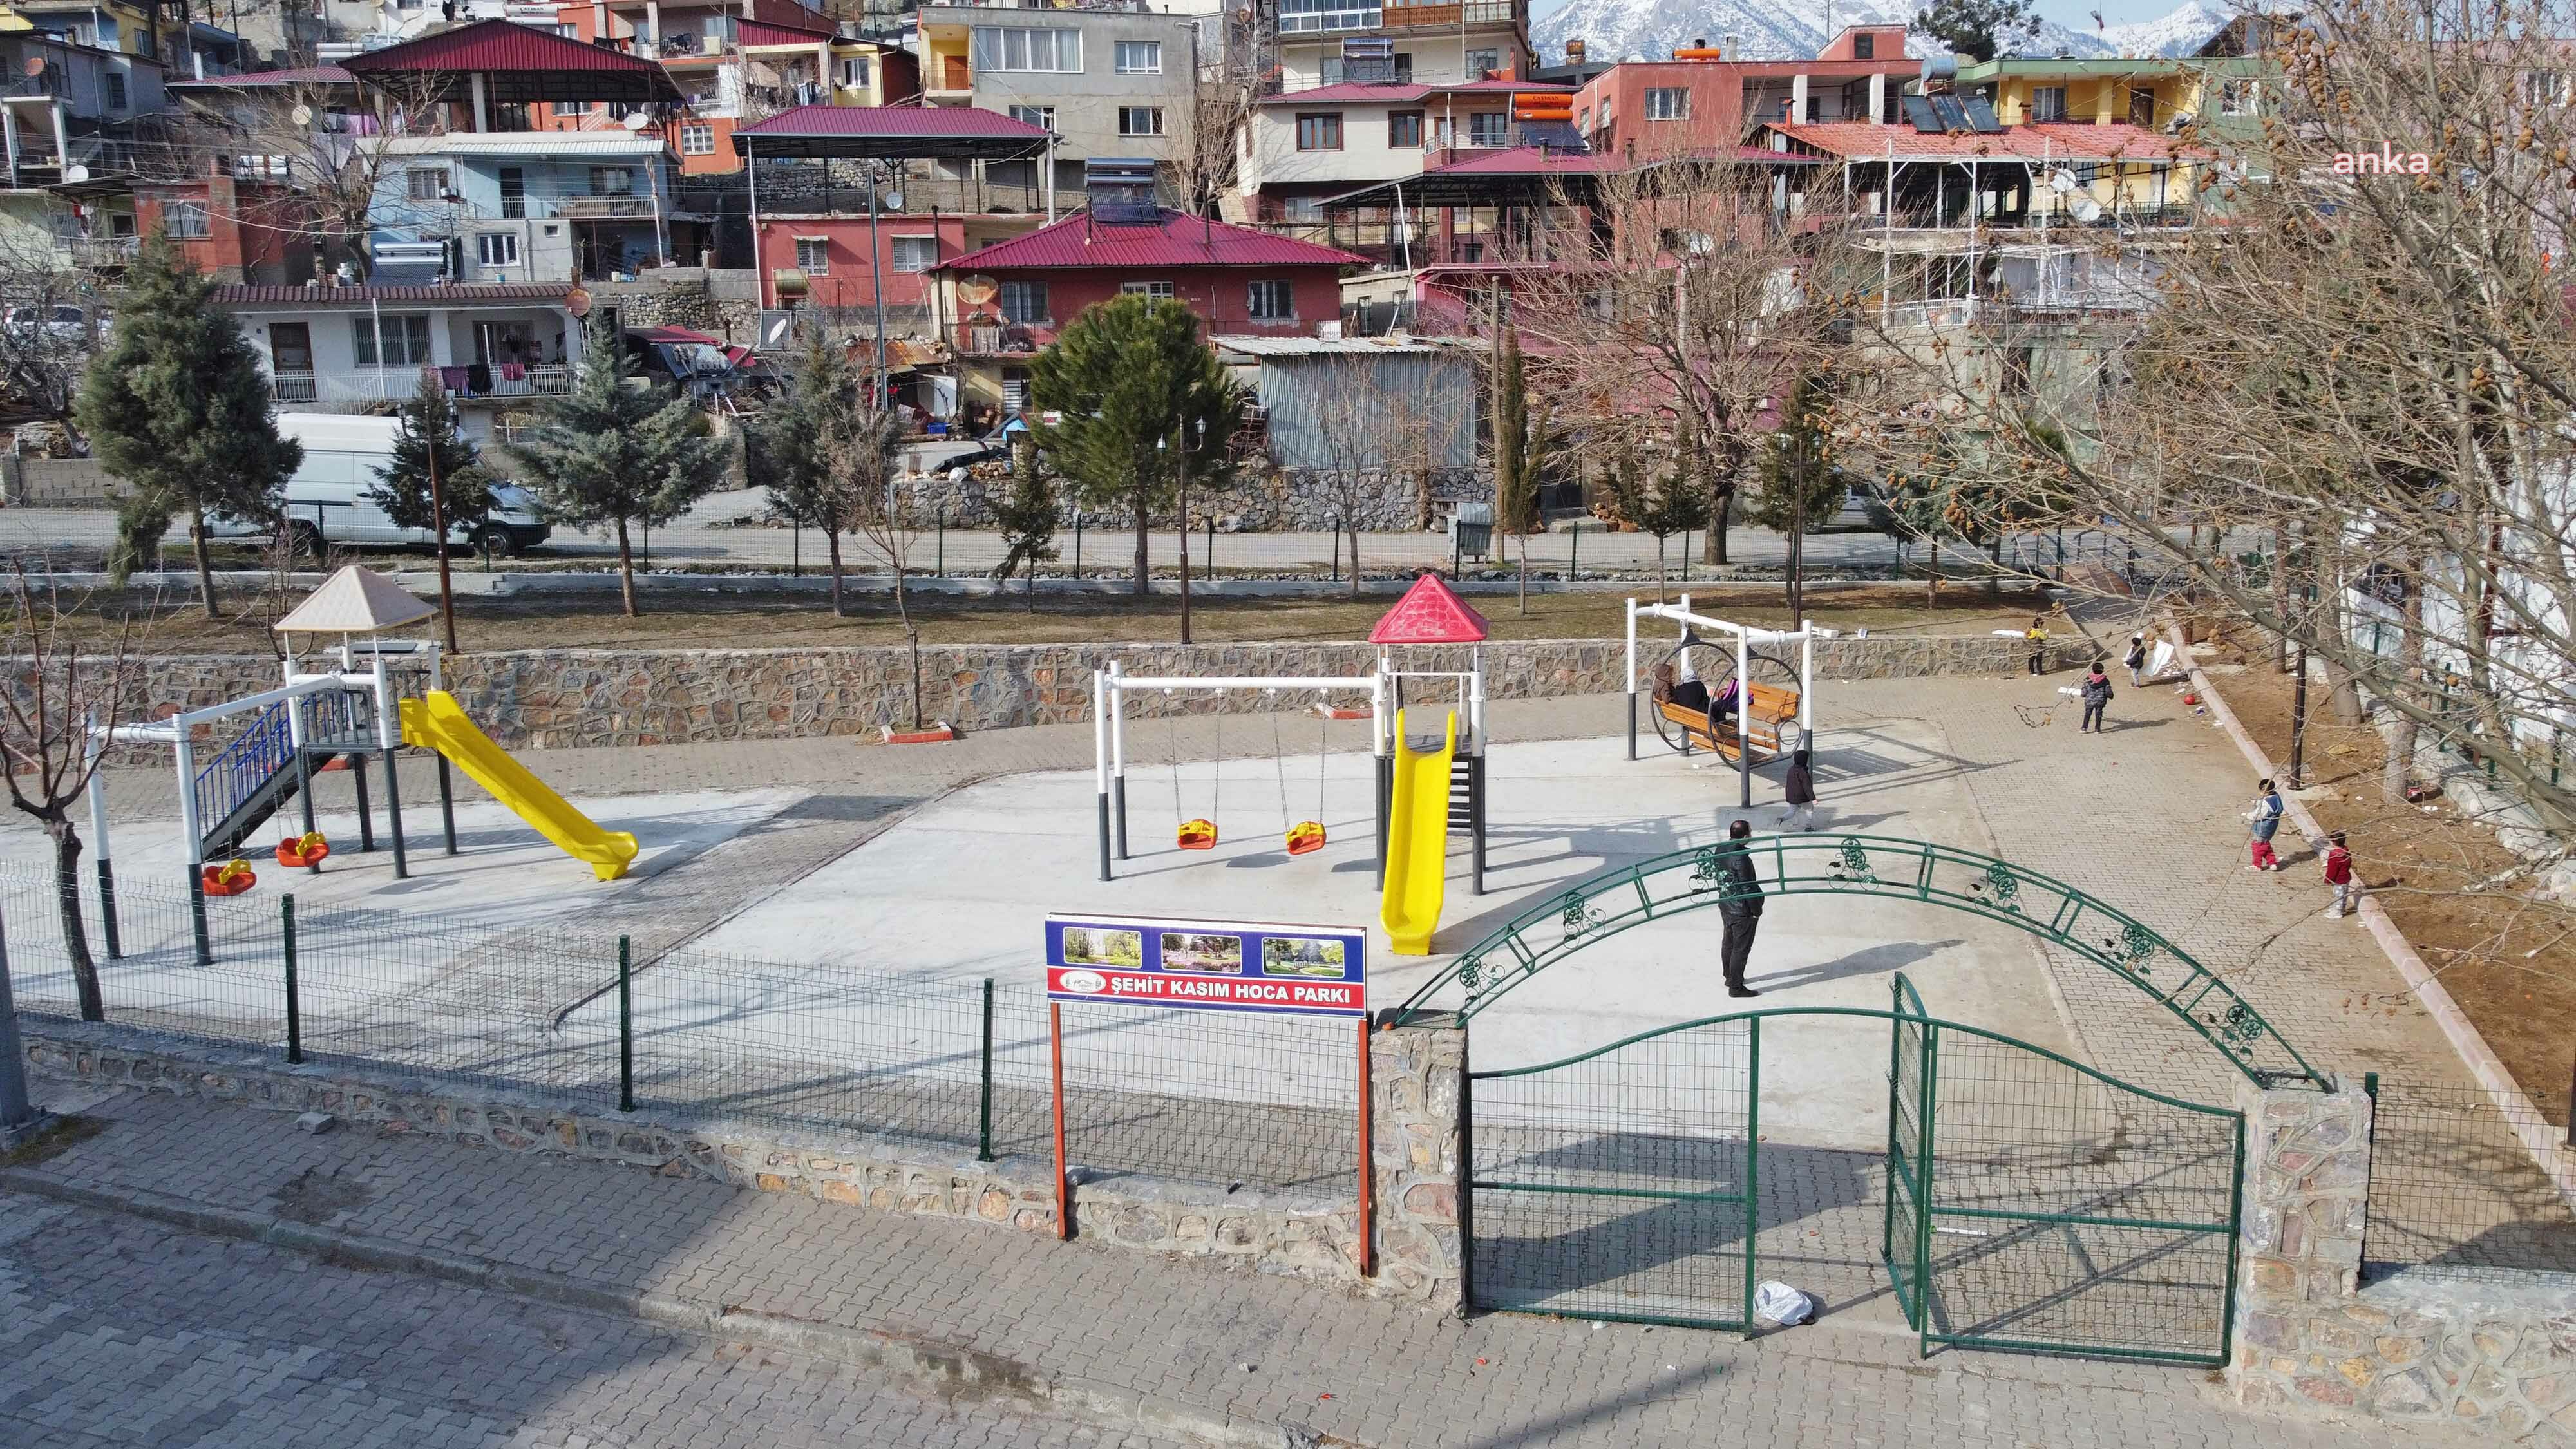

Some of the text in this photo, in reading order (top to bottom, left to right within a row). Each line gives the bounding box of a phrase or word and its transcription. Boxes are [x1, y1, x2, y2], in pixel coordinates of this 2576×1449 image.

[1112, 976, 1164, 994] ŞEHİT
[1171, 981, 1229, 998] KASIM
[1236, 985, 1289, 1000] HOCA
[1294, 987, 1350, 1003] PARKI
